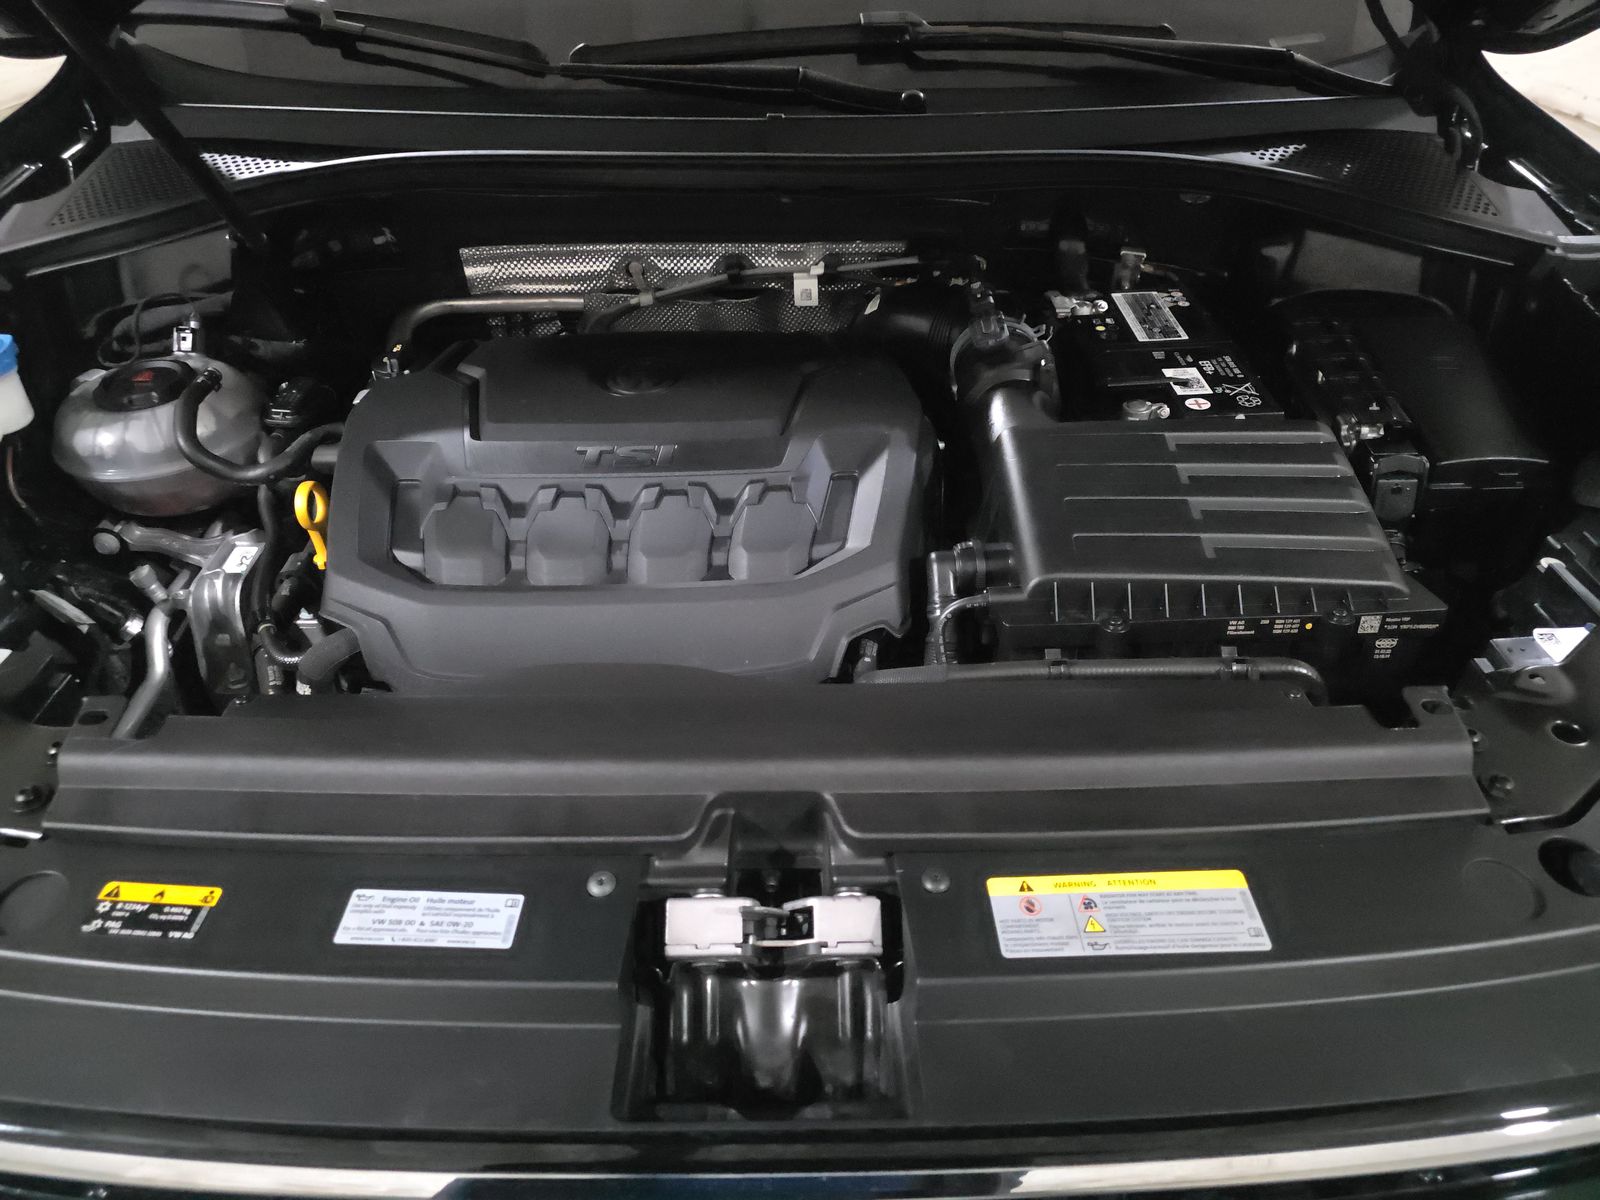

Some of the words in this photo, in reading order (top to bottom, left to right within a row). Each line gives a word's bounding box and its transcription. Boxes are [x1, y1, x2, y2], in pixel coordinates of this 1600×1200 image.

[575, 444, 678, 468] TSI
[1053, 880, 1097, 889] WARNING
[1107, 878, 1157, 887] ATTENTION
[382, 896, 408, 904] Engine
